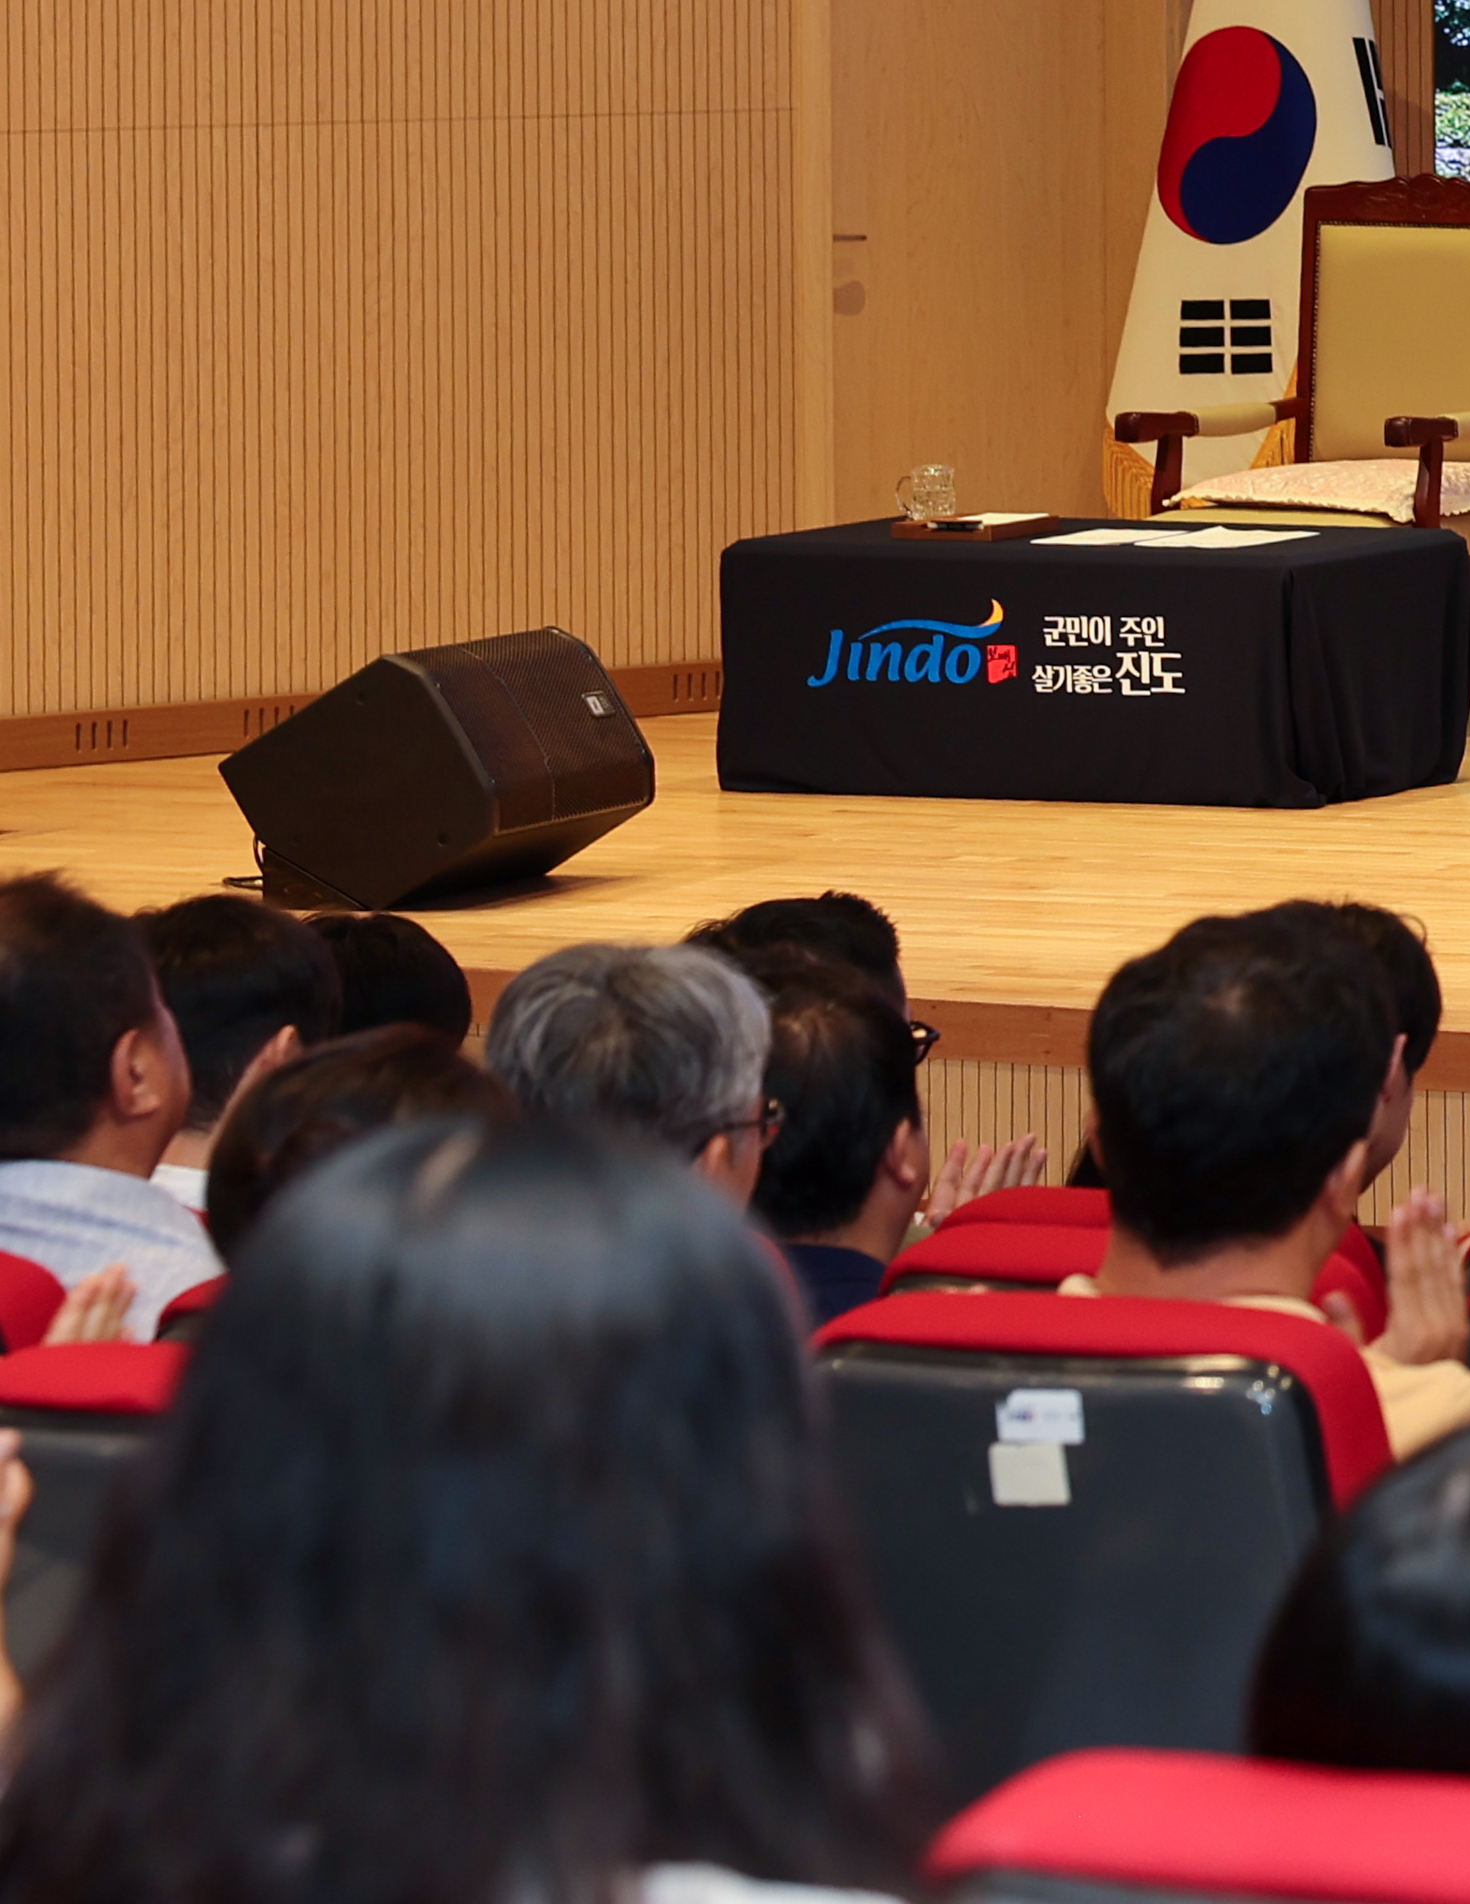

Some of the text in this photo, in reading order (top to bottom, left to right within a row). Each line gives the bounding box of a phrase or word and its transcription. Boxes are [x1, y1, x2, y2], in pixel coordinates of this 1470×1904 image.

[1042, 615, 1165, 647] 군민이 주인
[808, 630, 981, 687] Jindo
[1031, 664, 1113, 694] 살기좋은
[1115, 650, 1186, 696] 진도
